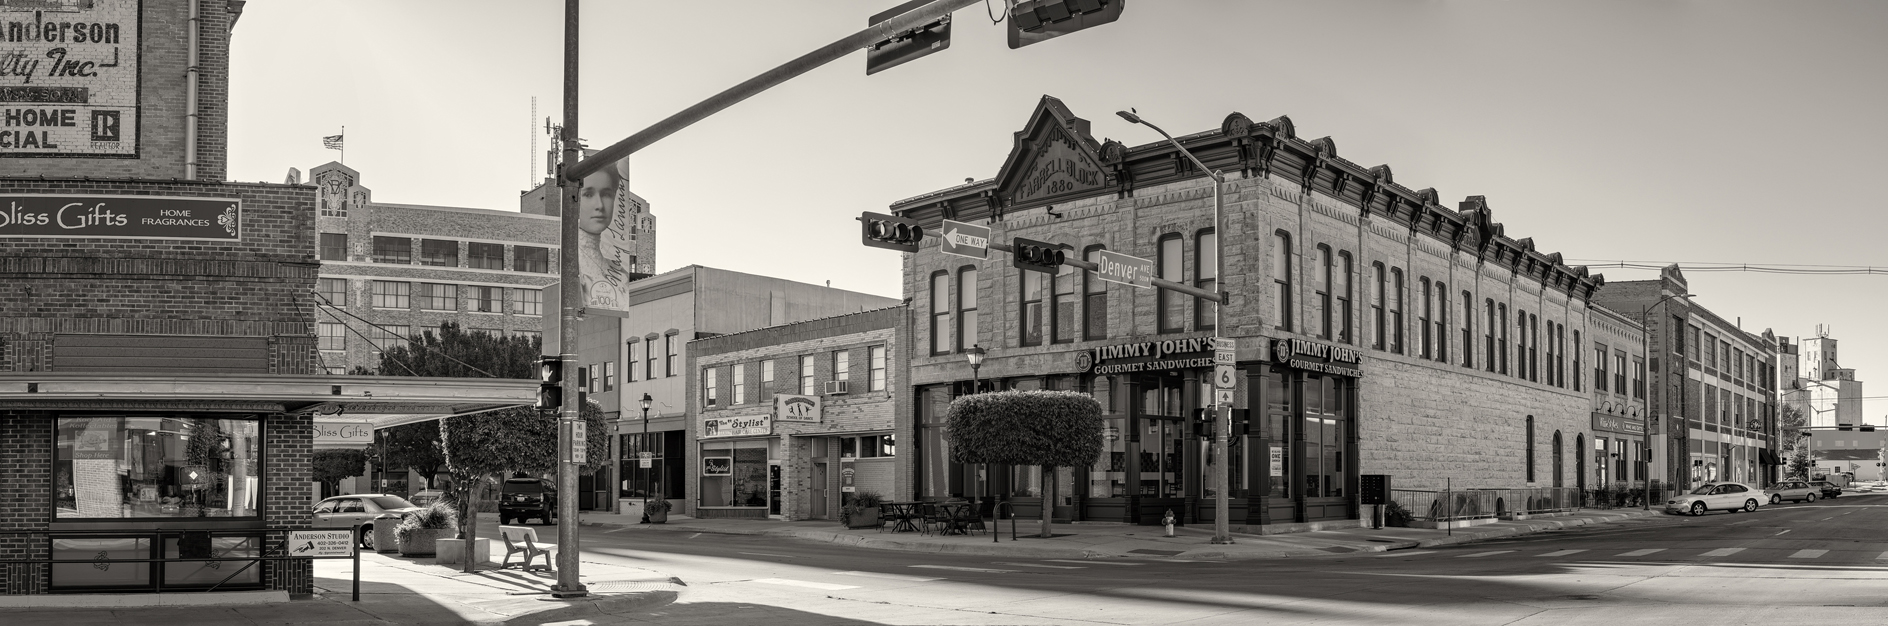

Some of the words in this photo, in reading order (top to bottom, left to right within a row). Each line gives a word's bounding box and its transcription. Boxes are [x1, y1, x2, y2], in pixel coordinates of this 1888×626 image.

[46, 47, 98, 77] Inc.
[5, 109, 76, 127] HOME
[90, 141, 120, 150] REALTOR
[1020, 157, 1065, 200] FARRELL
[1066, 158, 1099, 187] BLOCK
[1046, 179, 1073, 195] 1880
[56, 202, 128, 229] Gifts
[160, 209, 191, 218] HOME
[141, 217, 210, 227] FRAGRANCES
[956, 234, 969, 245] ONE
[970, 237, 985, 247] WAY
[605, 245, 630, 287] Mary
[1101, 255, 1138, 280] Denver
[1140, 264, 1150, 274] AVE
[597, 296, 610, 306] 100
[1094, 342, 1151, 364] JIMMY
[1155, 336, 1216, 359] JOHN'S
[1216, 340, 1235, 349] BUSINESS
[1291, 338, 1329, 359] JIMMY
[1329, 345, 1364, 365] JOHN'S
[1218, 353, 1234, 362] EAST
[1094, 362, 1145, 375] GOURMET
[1290, 358, 1324, 373] GOURMET
[1324, 363, 1364, 378] SANDWICHES
[1221, 370, 1230, 384] 6
[340, 425, 369, 439] Gifts
[575, 431, 583, 439] HOUR
